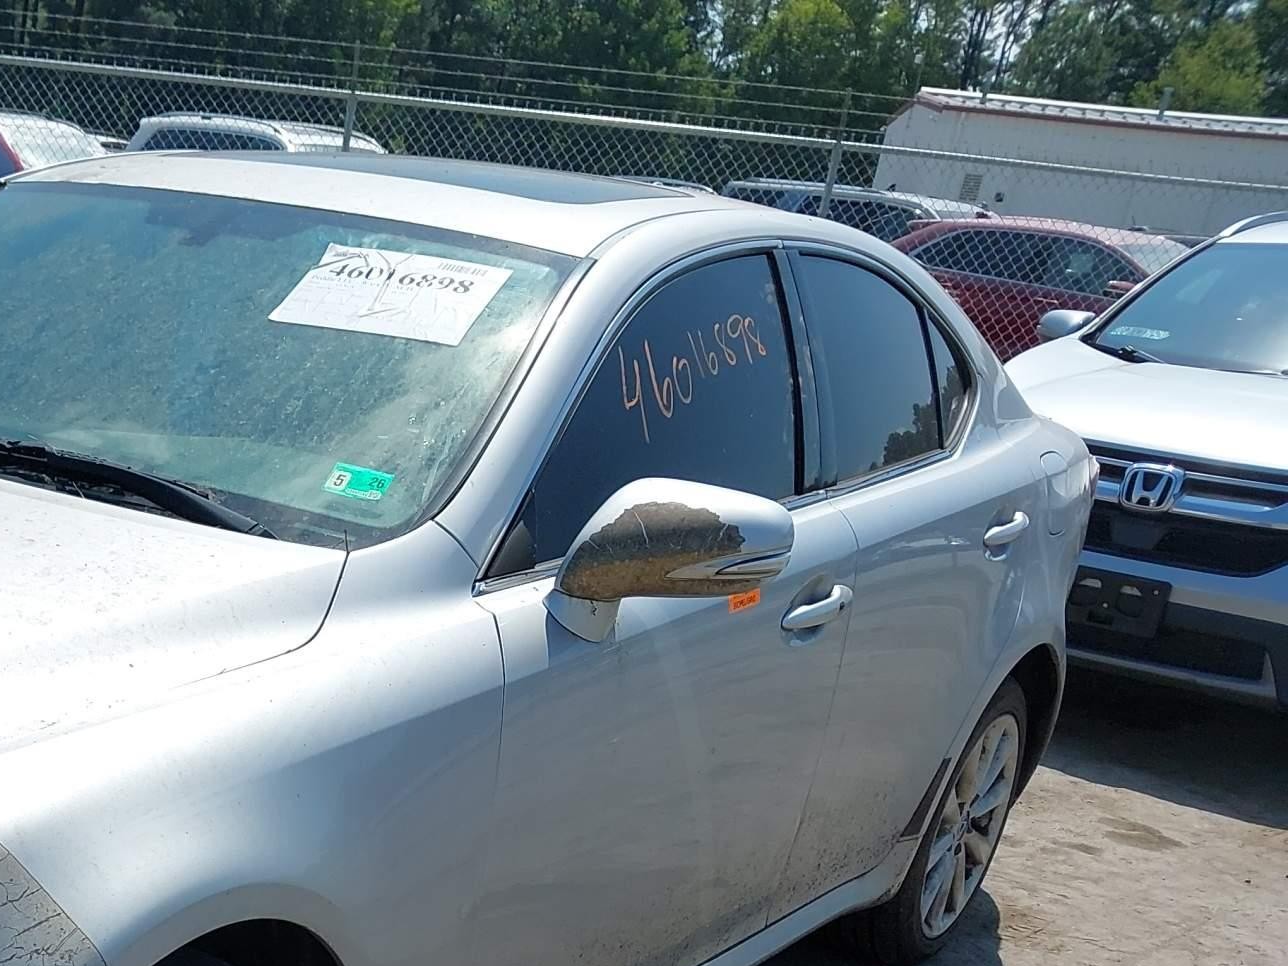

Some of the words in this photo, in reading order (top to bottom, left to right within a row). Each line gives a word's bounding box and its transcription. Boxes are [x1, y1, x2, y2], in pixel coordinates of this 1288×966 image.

[329, 262, 475, 294] 46016898
[617, 314, 767, 444] 46016898
[333, 473, 347, 487] 5
[368, 476, 387, 488] 26
